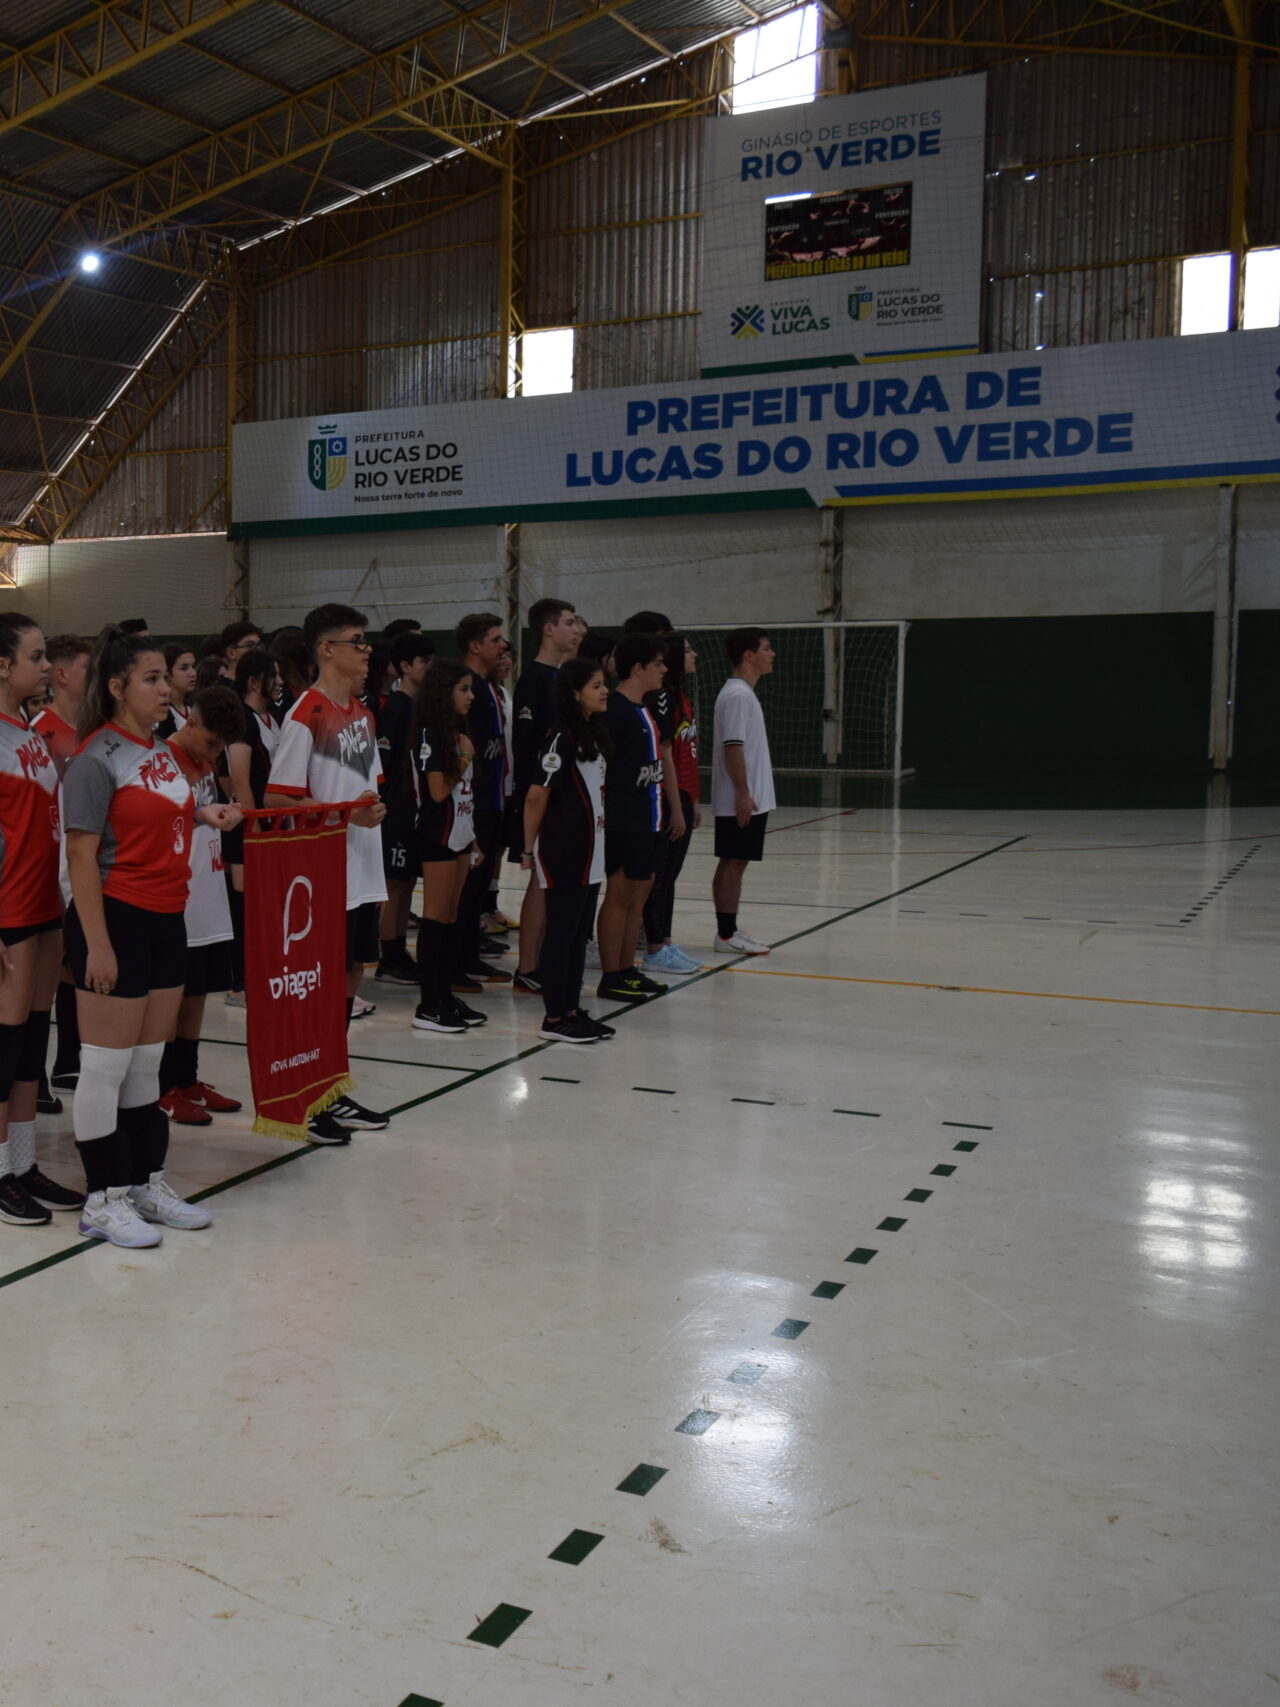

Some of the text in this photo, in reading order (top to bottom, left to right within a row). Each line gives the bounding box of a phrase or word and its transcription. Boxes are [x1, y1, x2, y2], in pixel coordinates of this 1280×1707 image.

[742, 110, 942, 153] GINÁSIO DE ESPORTES
[741, 129, 941, 181] RIO VERDE
[771, 305, 812, 320] VIVA
[877, 293, 941, 308] LUCAS DO
[877, 304, 944, 320] RIO VERDE
[772, 317, 830, 335] LUCAS
[627, 366, 1042, 436] PREFEITURA DE
[355, 430, 425, 444] PREFEITURA
[355, 442, 458, 466] LUCAS DO
[566, 412, 1133, 487] LUCAS DO RIO VERDE
[355, 464, 463, 488] RIO VERDE
[354, 488, 463, 503] Nossa terra forte de novo
[173, 816, 184, 854] 3
[391, 848, 407, 867] 15
[269, 961, 321, 1000] piaget
